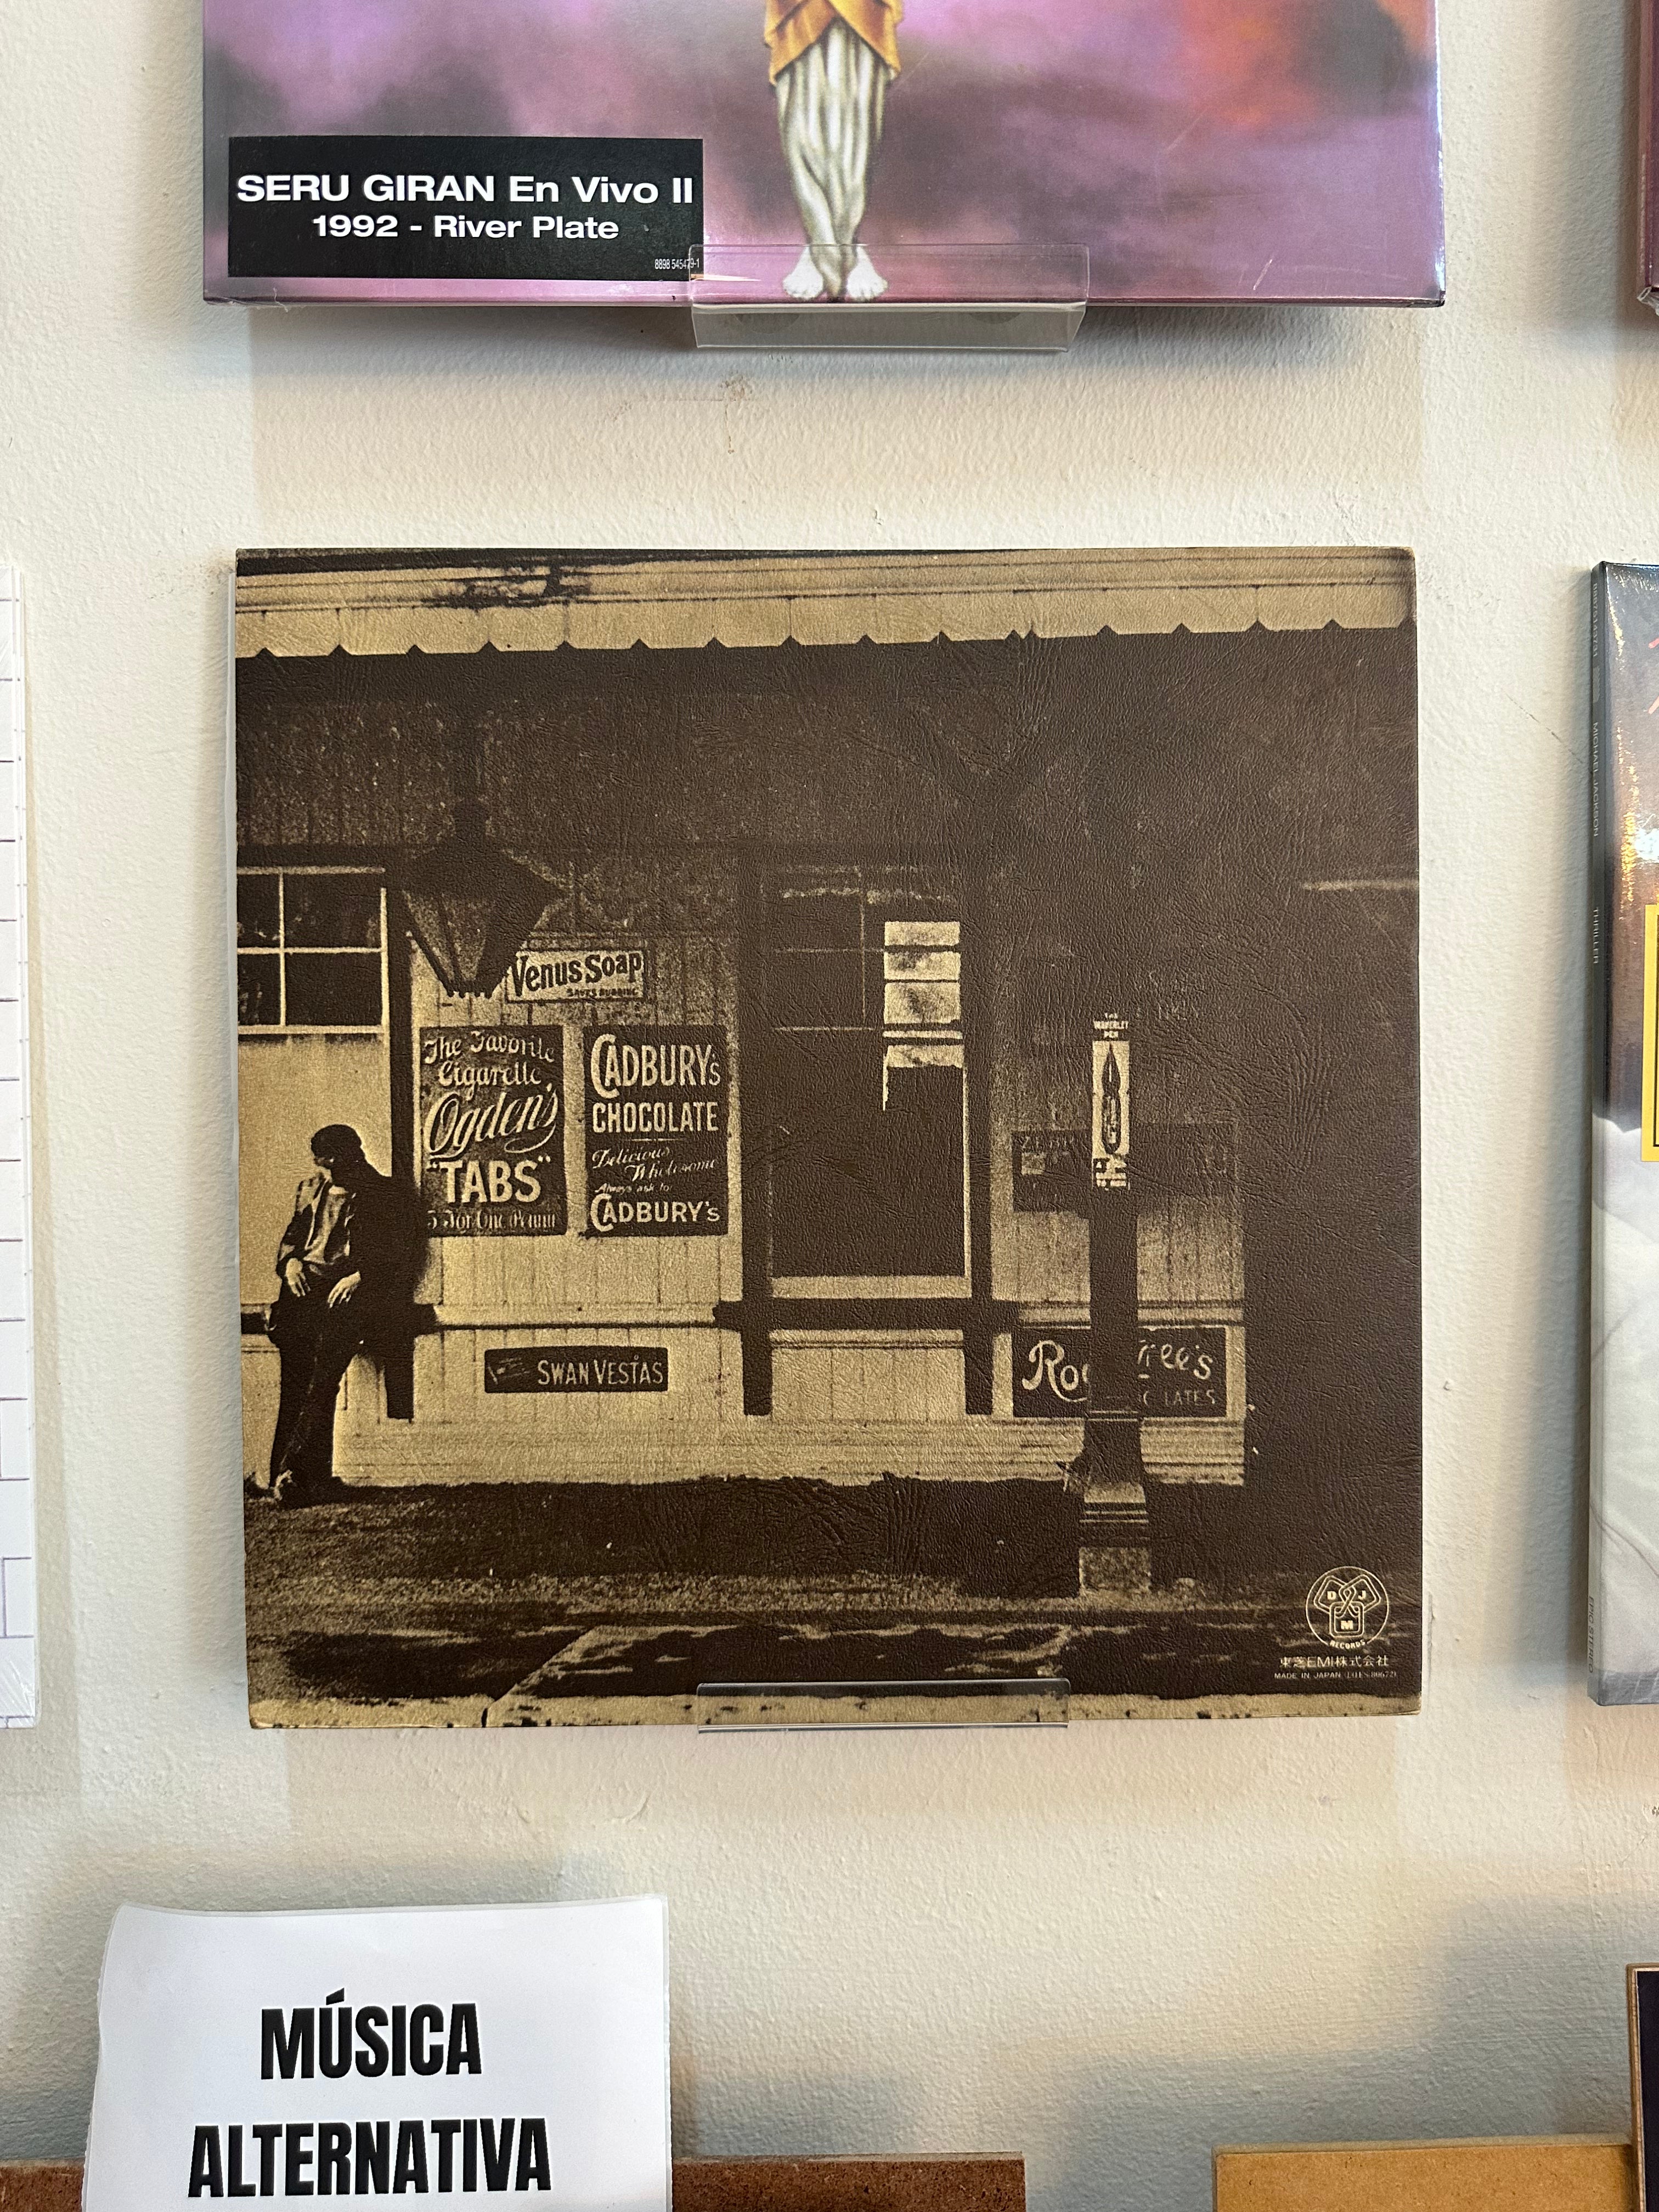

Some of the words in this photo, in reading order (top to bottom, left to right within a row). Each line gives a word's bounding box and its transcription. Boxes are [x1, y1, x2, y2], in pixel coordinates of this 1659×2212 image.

[237, 174, 349, 202] SERU
[363, 174, 495, 202] GIRAN
[510, 176, 559, 202] En
[571, 176, 658, 204] Vivo
[673, 177, 692, 204] II
[313, 215, 398, 238] 1992
[434, 215, 522, 238] River
[533, 216, 619, 239] Plate
[655, 258, 670, 269] 8898
[511, 955, 583, 997] Venus
[585, 953, 641, 983] Soap
[425, 1036, 462, 1064] The
[423, 1083, 558, 1159] Ogden's
[592, 1102, 719, 1133] CHOCOLATE
[538, 1359, 589, 1385] SWAN
[594, 1359, 663, 1385] VESTAS
[1329, 1639, 1366, 1650] RECORDS
[261, 1987, 482, 2080] MÚSICA
[188, 2118, 551, 2198] ALTERNATIVA
